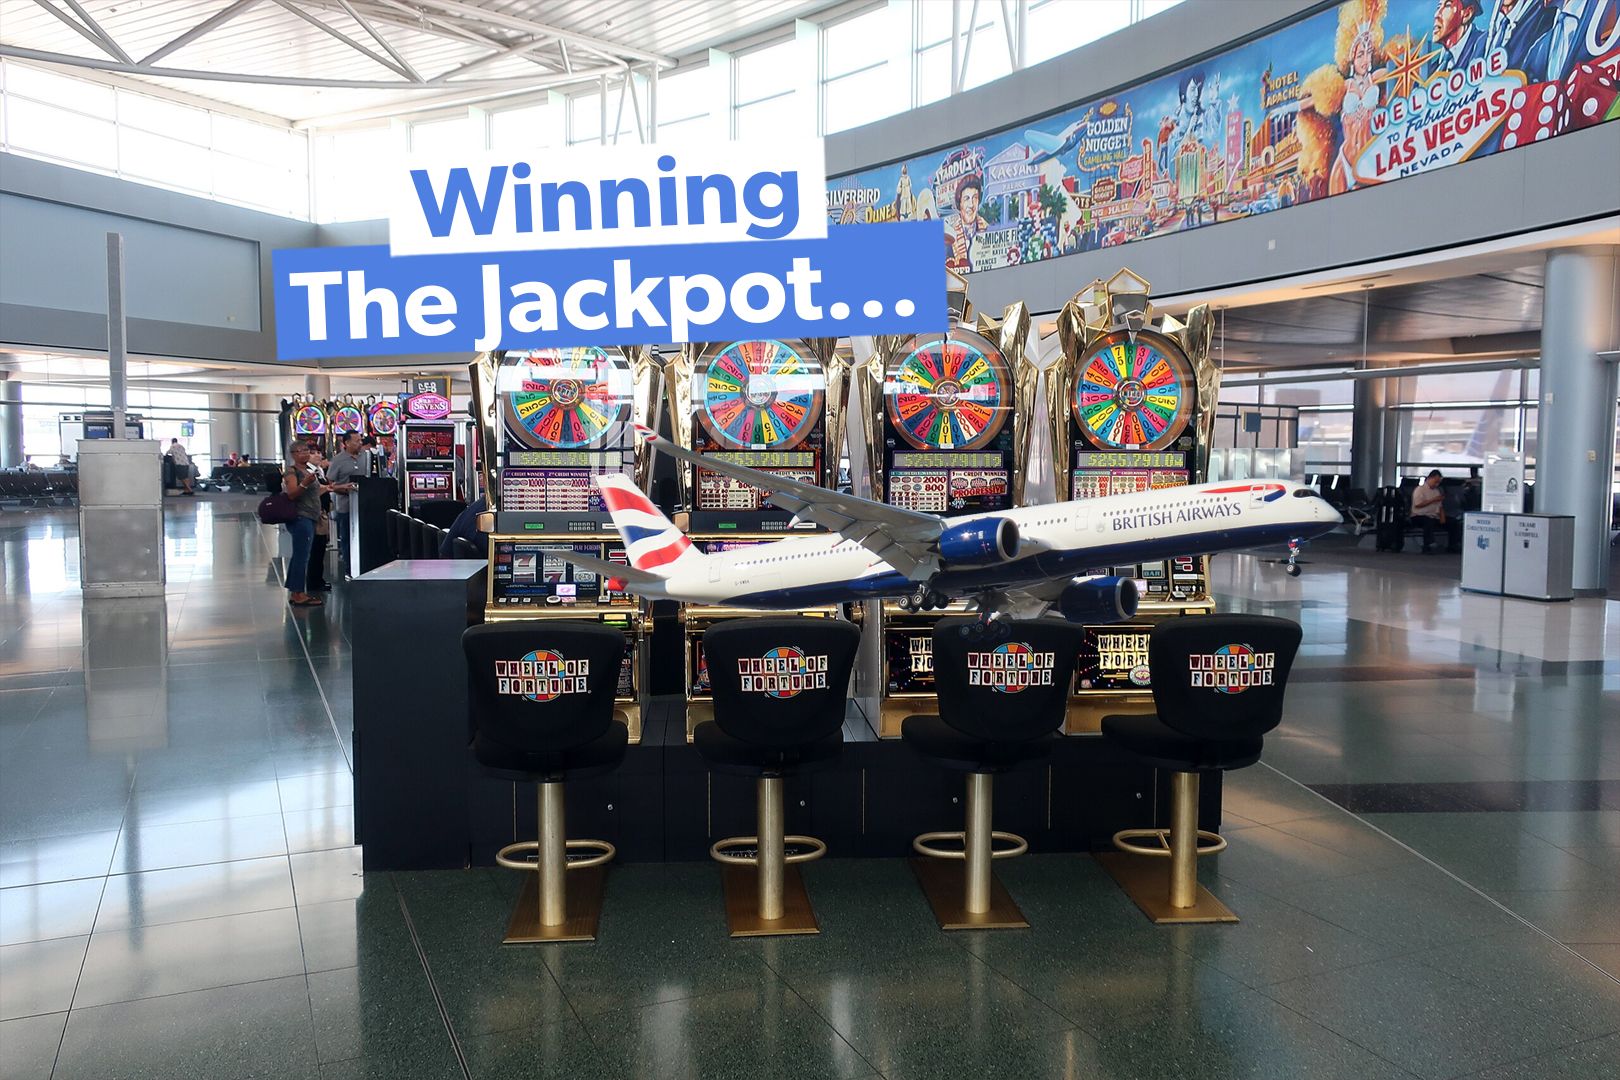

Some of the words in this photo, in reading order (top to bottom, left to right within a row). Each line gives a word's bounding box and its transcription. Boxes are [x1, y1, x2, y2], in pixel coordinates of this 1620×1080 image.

[1269, 71, 1299, 91] HOTEL
[1266, 86, 1300, 107] APACHE
[1373, 52, 1502, 130] WELCOME
[1387, 132, 1400, 144] TO
[1406, 87, 1483, 138] Fabulous
[1087, 116, 1128, 137] GOLDEN
[1375, 136, 1416, 176] LAS
[1423, 88, 1506, 151] VEGAS
[1084, 134, 1129, 153] NUGGET
[1400, 141, 1464, 178] NEVADA
[990, 163, 1041, 181] CAESARS
[825, 188, 881, 207] SILVERBIRD
[1108, 203, 1129, 215] HALL
[984, 229, 1010, 245] MICKIE
[1115, 346, 1124, 366] 75
[1127, 346, 1134, 365] 60
[1136, 347, 1146, 366] 30
[719, 358, 744, 380] 125
[961, 361, 985, 382] 250
[1092, 360, 1109, 376] 25
[1103, 352, 1120, 378] 100
[1151, 362, 1167, 377] 50
[708, 382, 738, 392] 250
[973, 373, 992, 384] 75
[1081, 383, 1100, 392] 20
[1086, 371, 1112, 387] 400
[1147, 374, 1174, 389] 100
[414, 401, 446, 410] SEVENS
[520, 398, 548, 415] 250
[897, 395, 917, 404] 25
[901, 400, 928, 415] 400
[1148, 395, 1176, 406] 250
[1084, 404, 1102, 416] 50
[1091, 406, 1114, 427] 100
[1142, 407, 1164, 428] 125
[538, 409, 556, 435] 100
[768, 410, 786, 437] 100
[780, 413, 797, 428] 25
[967, 413, 984, 429] 25
[1100, 418, 1113, 435] 40
[550, 421, 560, 441] 50
[741, 422, 751, 441] 30
[764, 422, 774, 442] 75
[922, 476, 947, 484] 2000
[924, 483, 945, 492] 800
[953, 484, 1004, 497] PROGRESSIVE
[1112, 511, 1173, 531] BRITISH
[1176, 502, 1242, 523] AIRWAYS
[1098, 634, 1151, 652] WHEE
[495, 659, 558, 677] WHEEL
[565, 659, 589, 676] OF
[738, 657, 800, 675] WHEEL
[805, 655, 828, 672] OF
[967, 652, 1027, 669] WHEEL
[1033, 652, 1055, 669] OF
[1189, 654, 1249, 671] WHEEL
[1254, 652, 1275, 670] OF
[498, 676, 587, 694] FORTUNE
[741, 672, 826, 692] FORTUNE
[969, 669, 1052, 686] FORTUNE
[1190, 669, 1273, 687] FORTUNE
